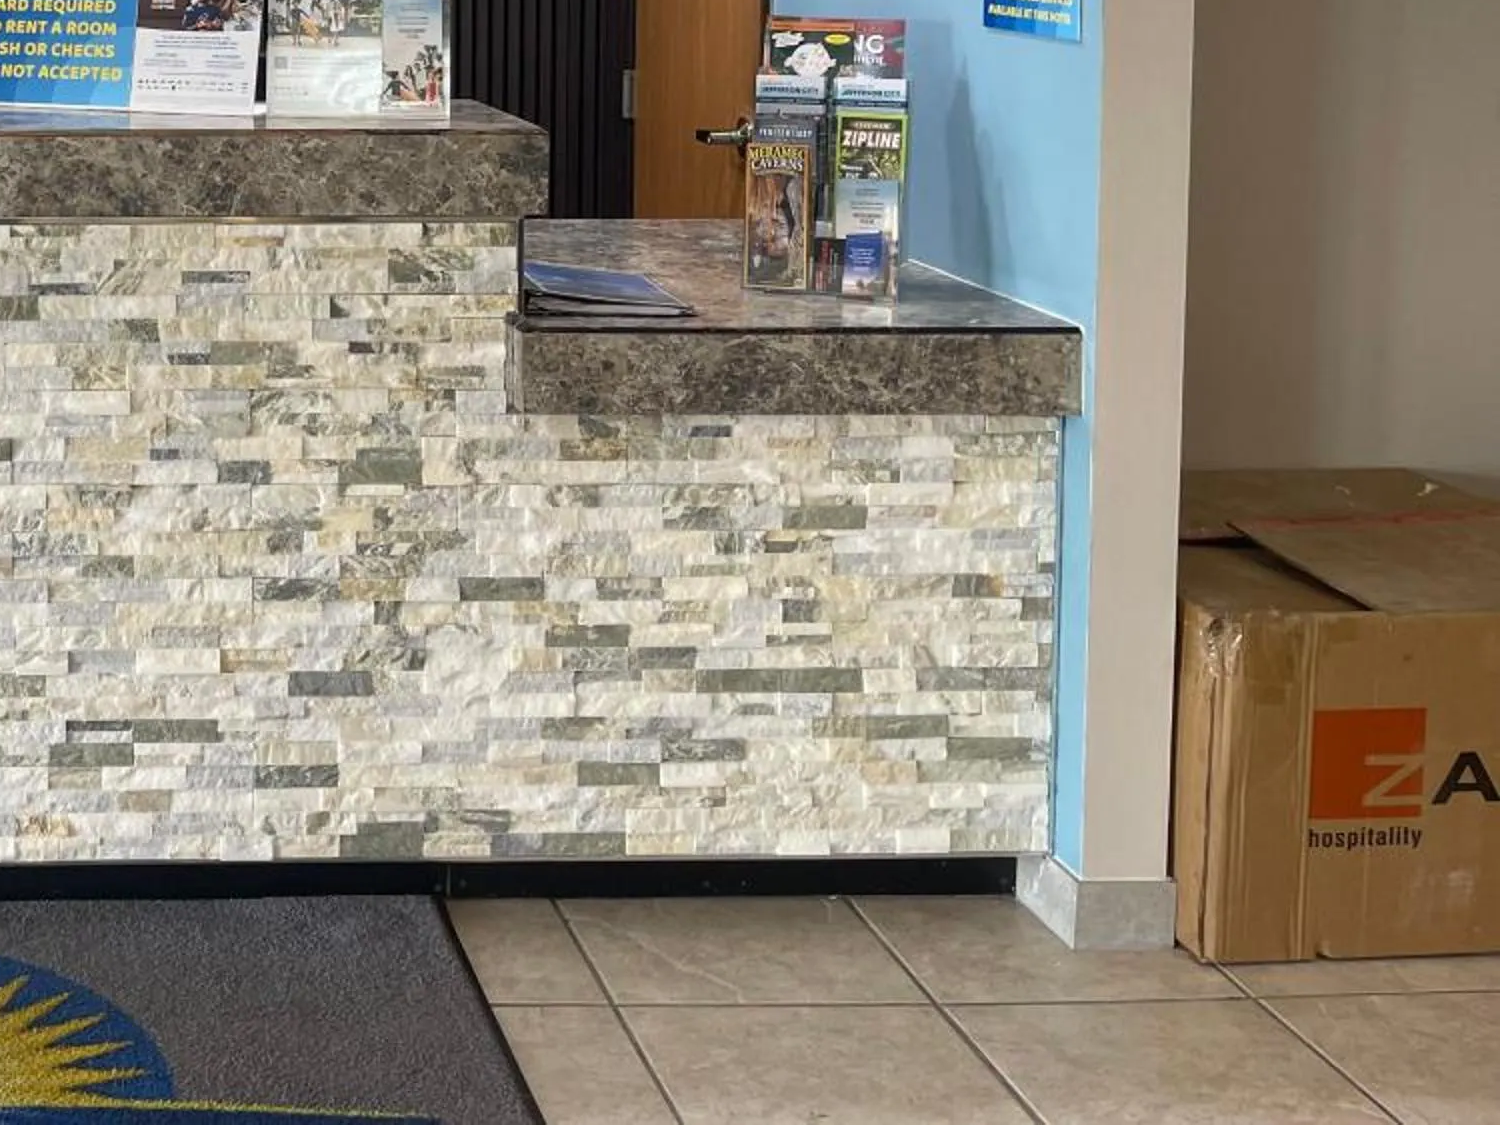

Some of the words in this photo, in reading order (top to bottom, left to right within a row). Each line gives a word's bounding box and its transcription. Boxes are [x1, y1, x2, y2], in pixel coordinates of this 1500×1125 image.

[5, 19, 49, 34] RENT
[51, 21, 61, 34] A
[66, 21, 117, 36] ROOM
[24, 42, 47, 56] OR
[51, 43, 116, 58] CHECKS
[1, 64, 35, 79] NOT
[38, 65, 123, 82] ACCEPTED
[842, 130, 902, 149] ZIPLINE
[1308, 826, 1423, 851] hospitality
